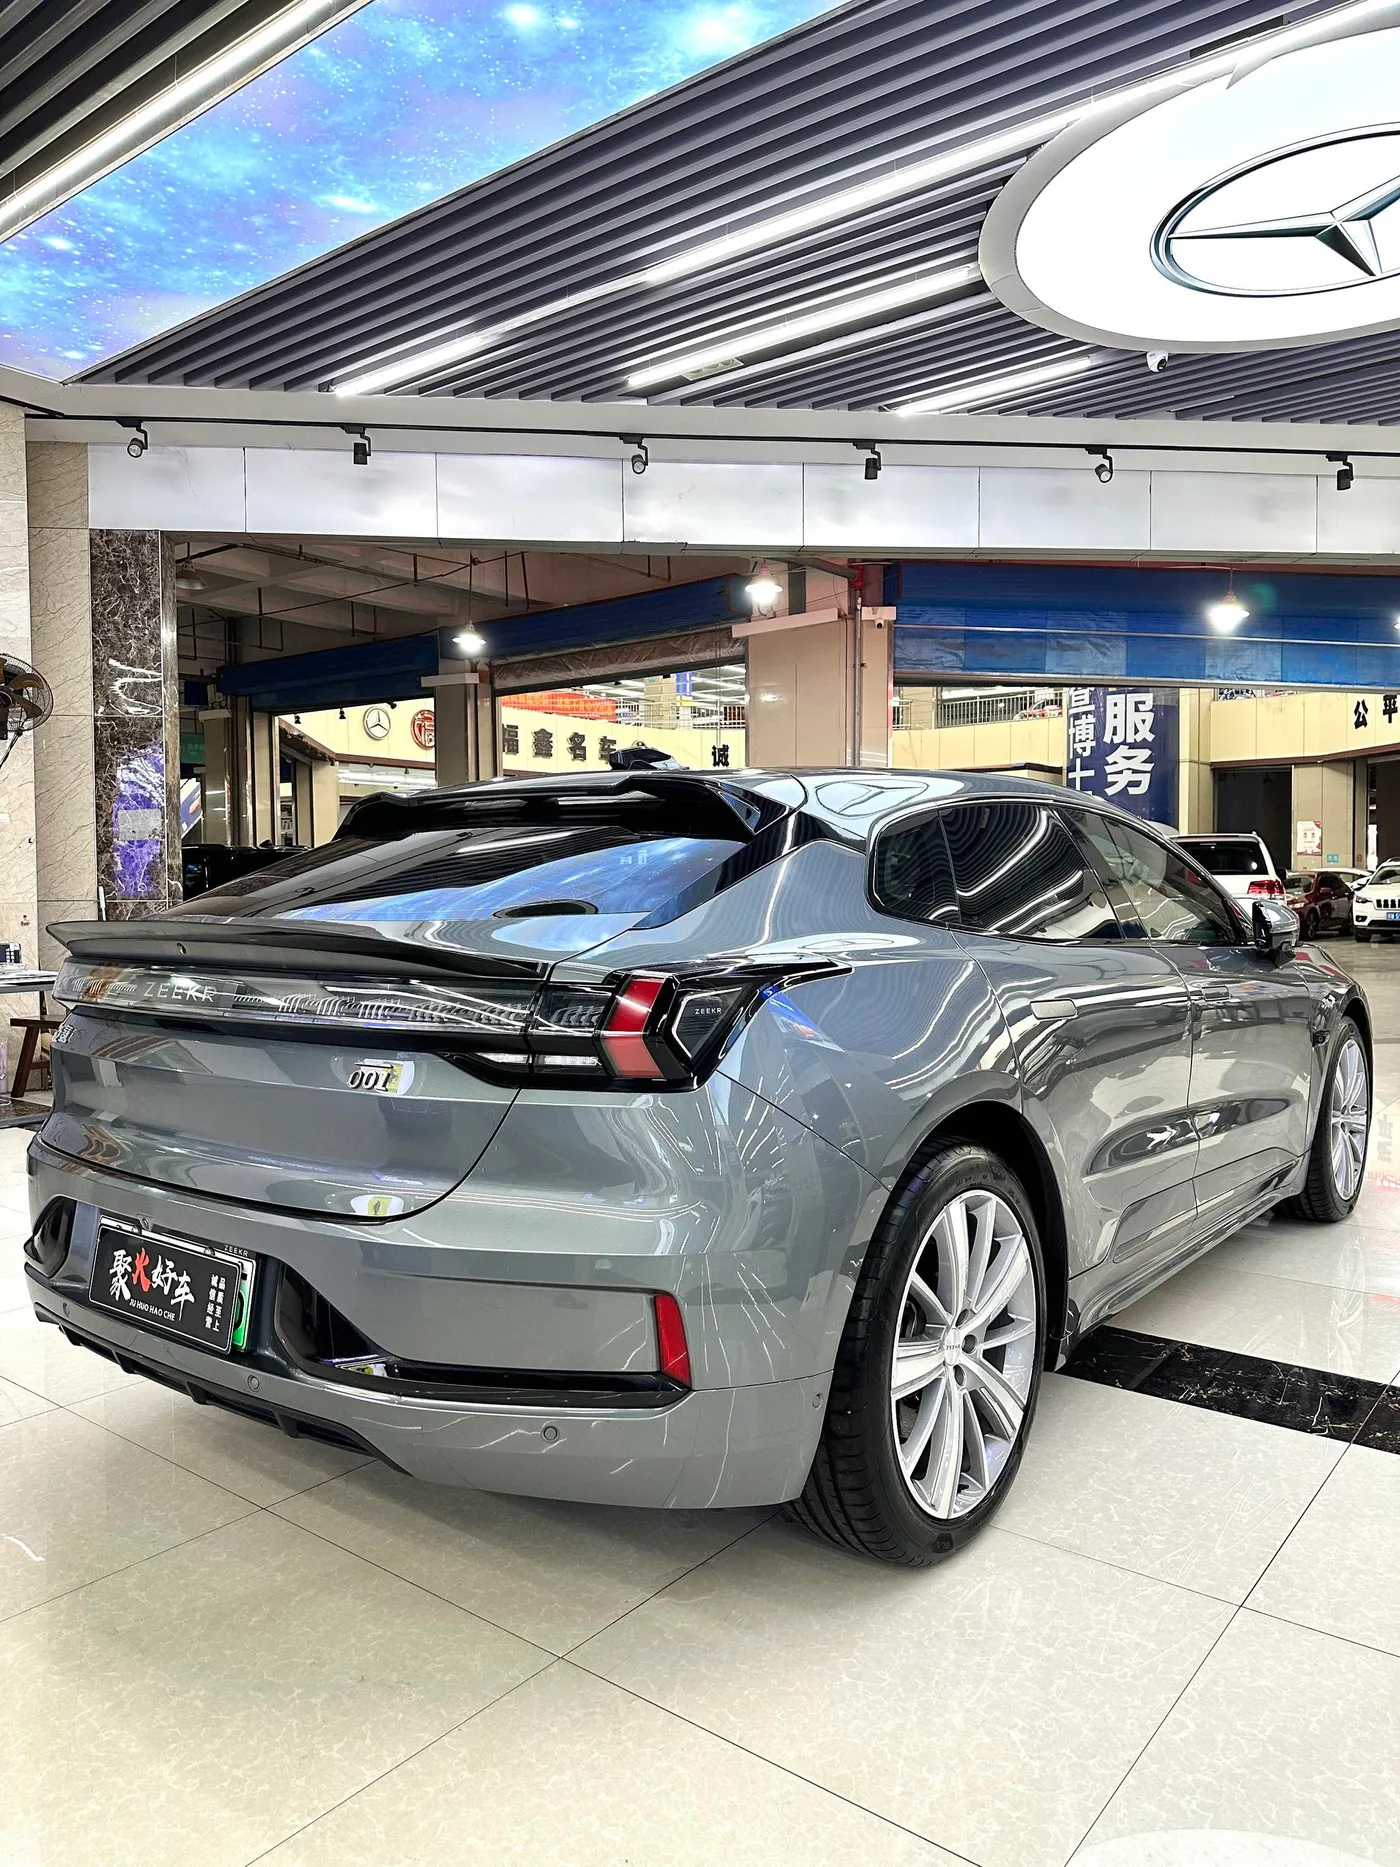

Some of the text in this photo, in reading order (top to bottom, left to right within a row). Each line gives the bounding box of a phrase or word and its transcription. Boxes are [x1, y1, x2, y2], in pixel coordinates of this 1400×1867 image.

[1354, 694, 1398, 730] 公平
[712, 743, 729, 767] 诚
[1103, 692, 1156, 796] 服务
[143, 981, 219, 1003] ZEEKR
[694, 1007, 722, 1015] ZEEKR
[346, 1069, 391, 1092] 001
[224, 1244, 249, 1257] ZEEKR
[109, 1247, 195, 1322] 聚火好车
[136, 1300, 150, 1312] HUO
[149, 1304, 163, 1317] HAO
[163, 1310, 176, 1322] CHE
[212, 1277, 226, 1332] 品质至上
